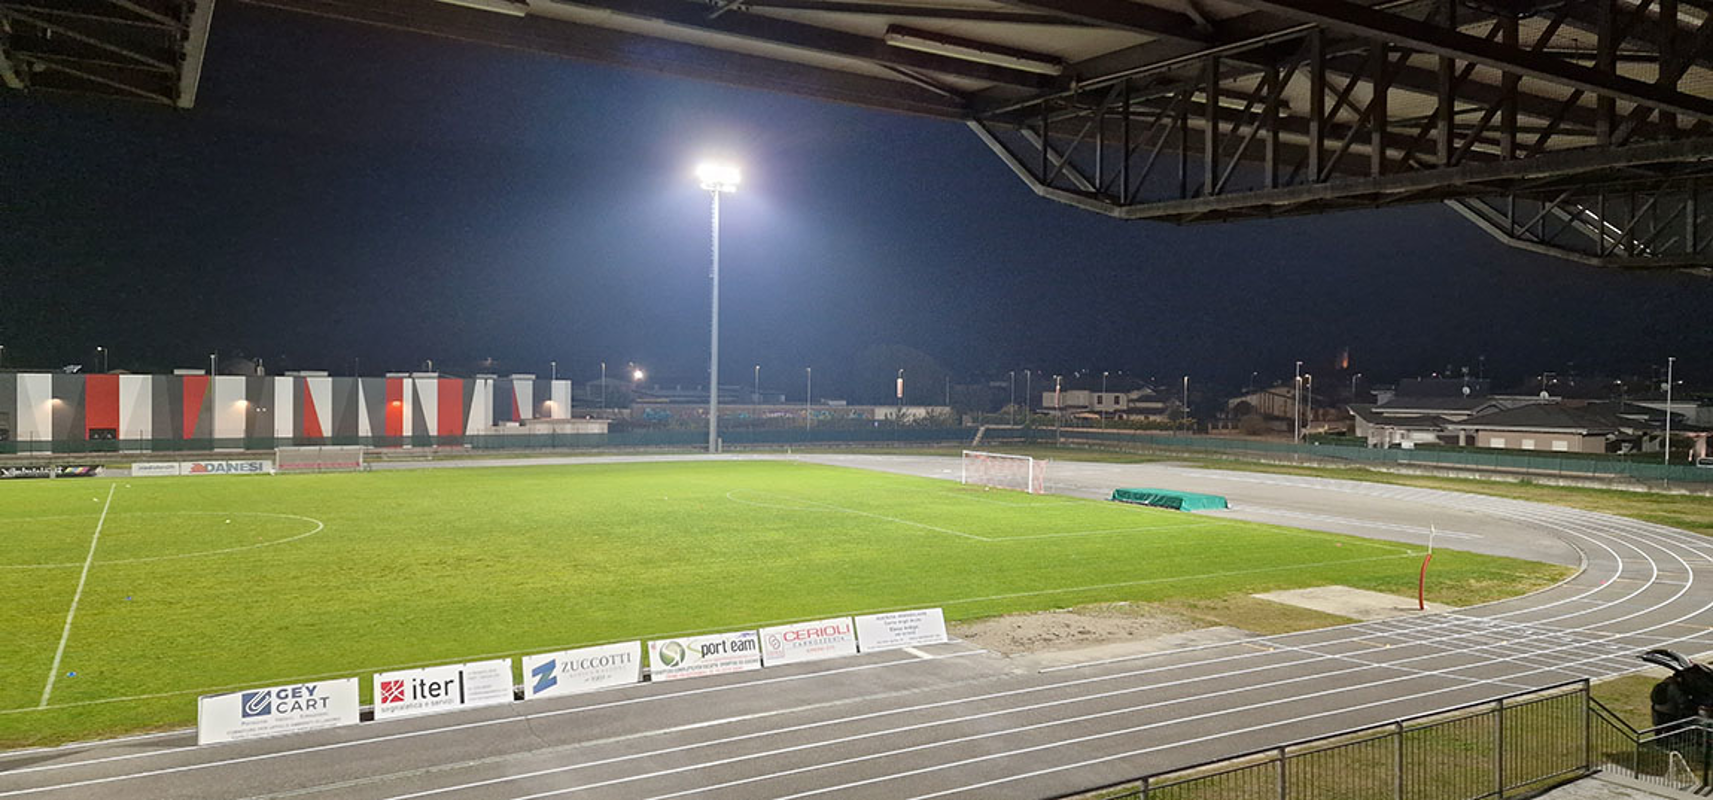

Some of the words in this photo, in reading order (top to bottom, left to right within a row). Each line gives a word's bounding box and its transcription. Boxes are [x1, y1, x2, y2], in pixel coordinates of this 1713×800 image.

[205, 462, 263, 473] DANESI
[783, 624, 850, 642] CERIOLI
[561, 652, 631, 673] ZUCCOTTI
[275, 685, 318, 700] GEY
[412, 678, 455, 700] iter
[276, 696, 330, 714] CART
